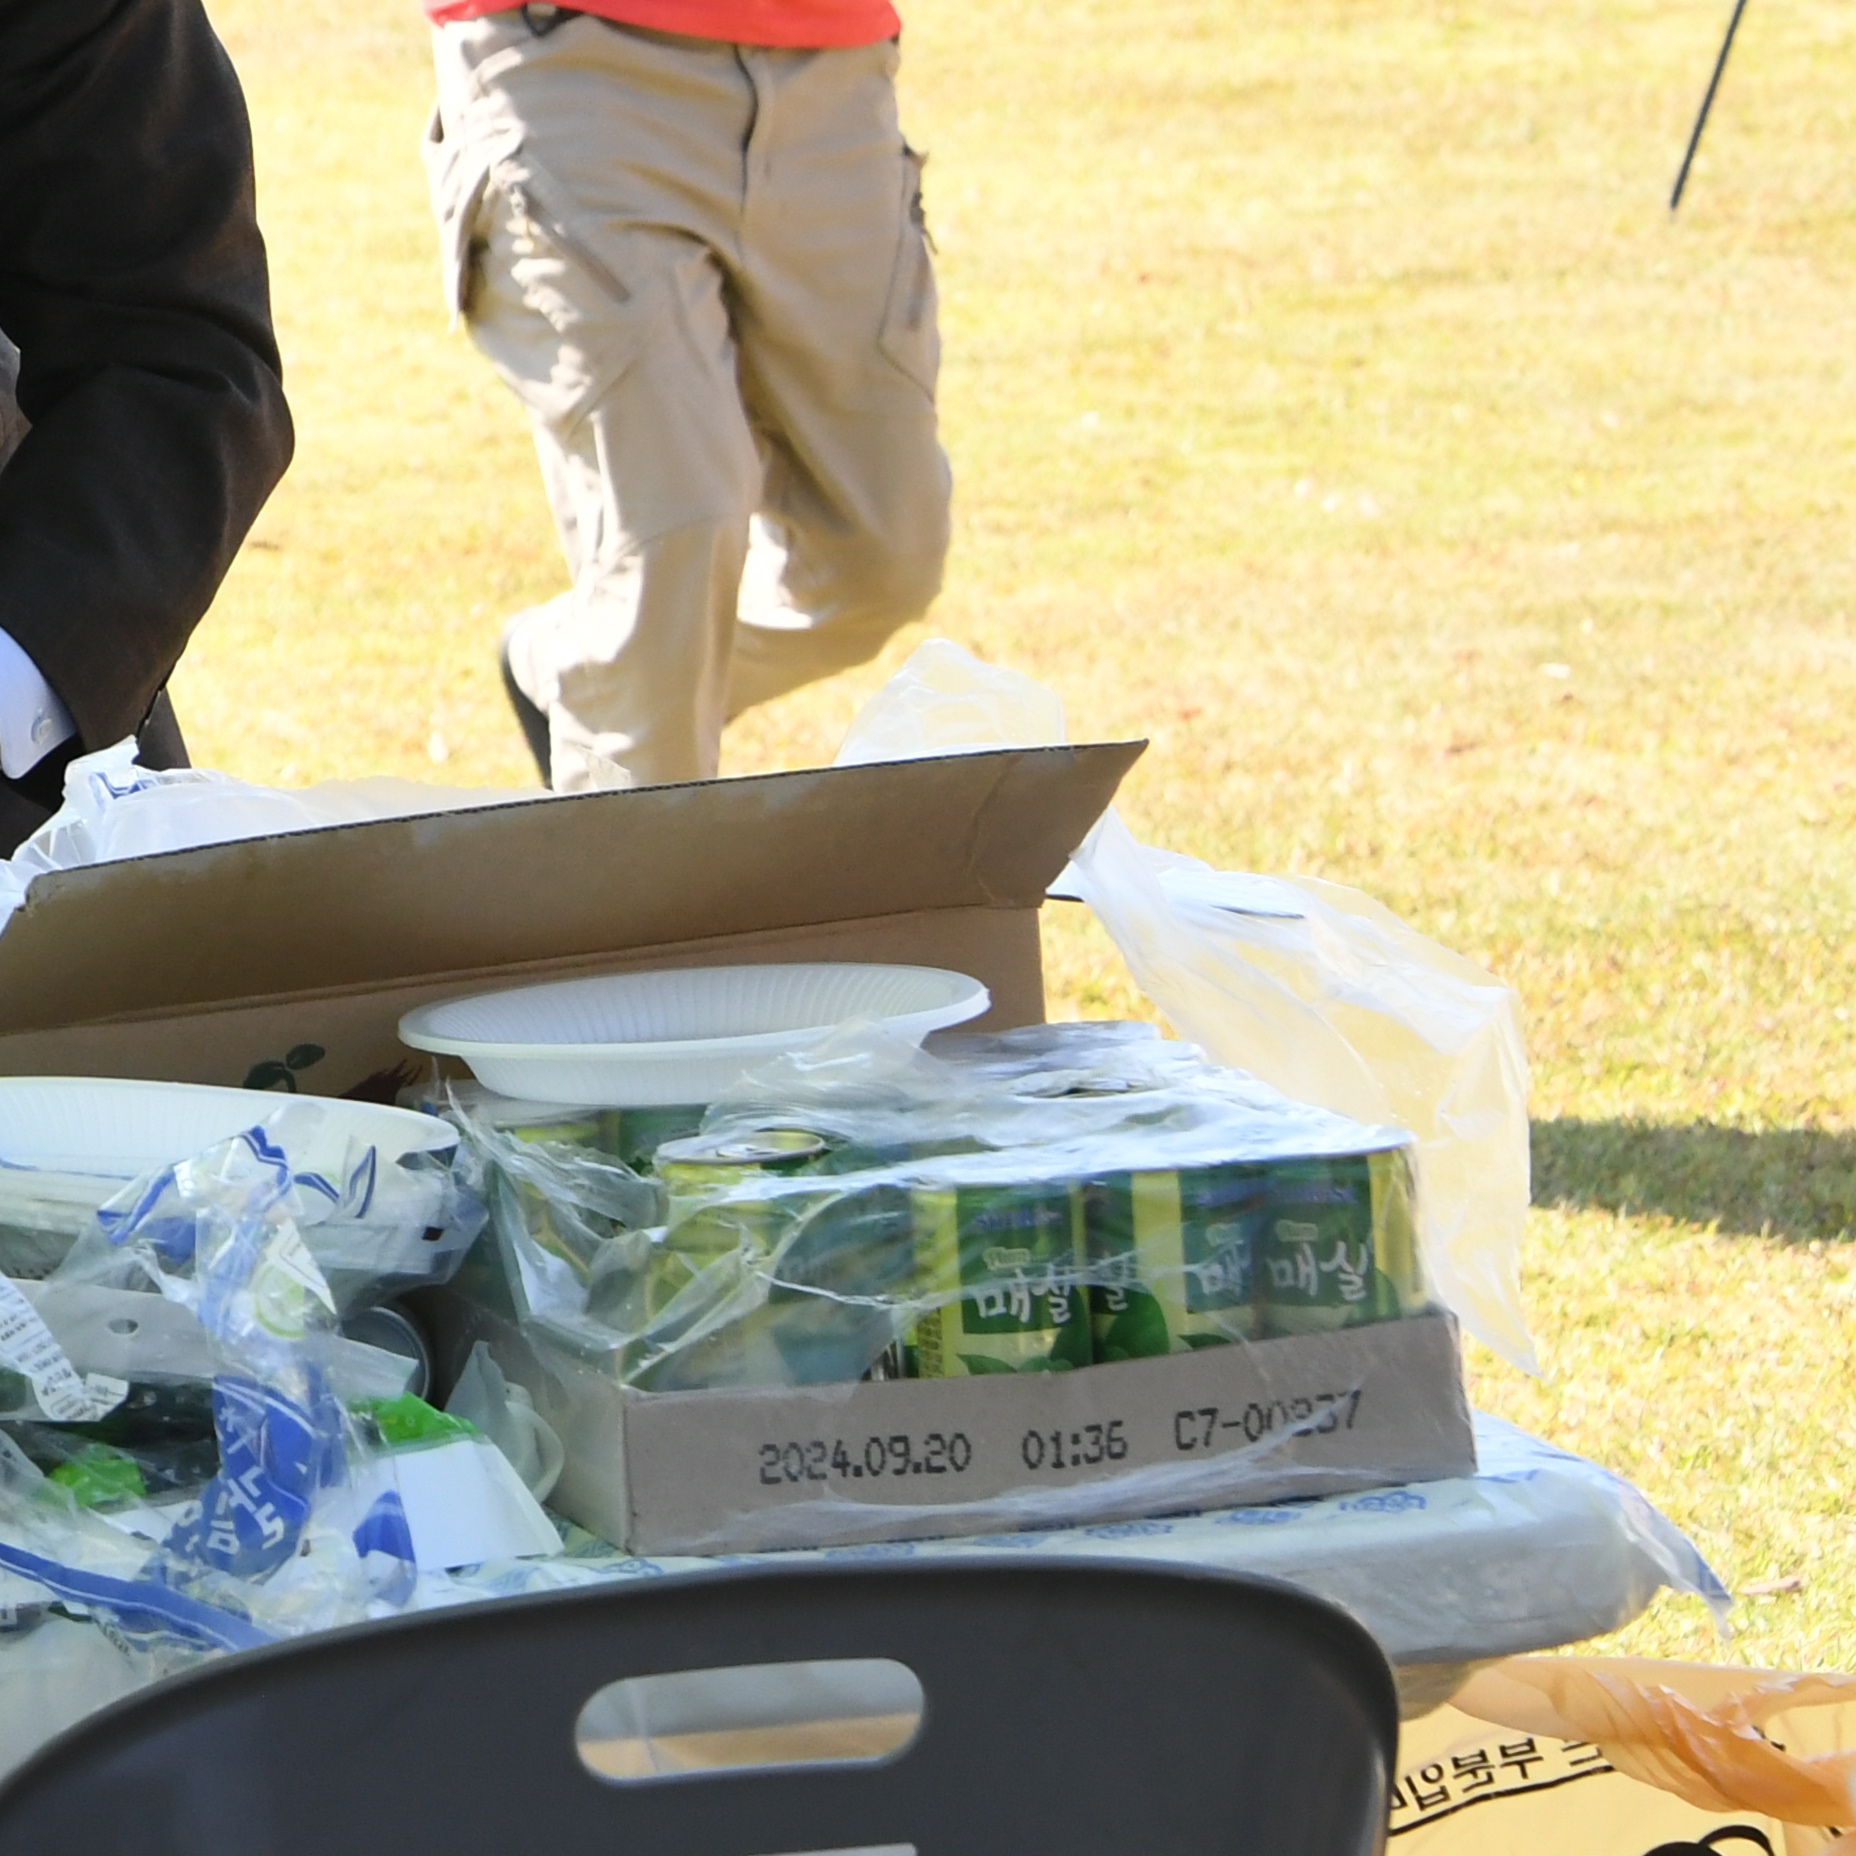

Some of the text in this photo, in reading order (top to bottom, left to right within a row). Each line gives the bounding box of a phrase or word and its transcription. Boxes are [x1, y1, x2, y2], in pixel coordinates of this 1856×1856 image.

[1266, 1241, 1369, 1302] 매실
[758, 1431, 972, 1485] 2024.09.20
[1021, 1420, 1129, 1471] 01:36
